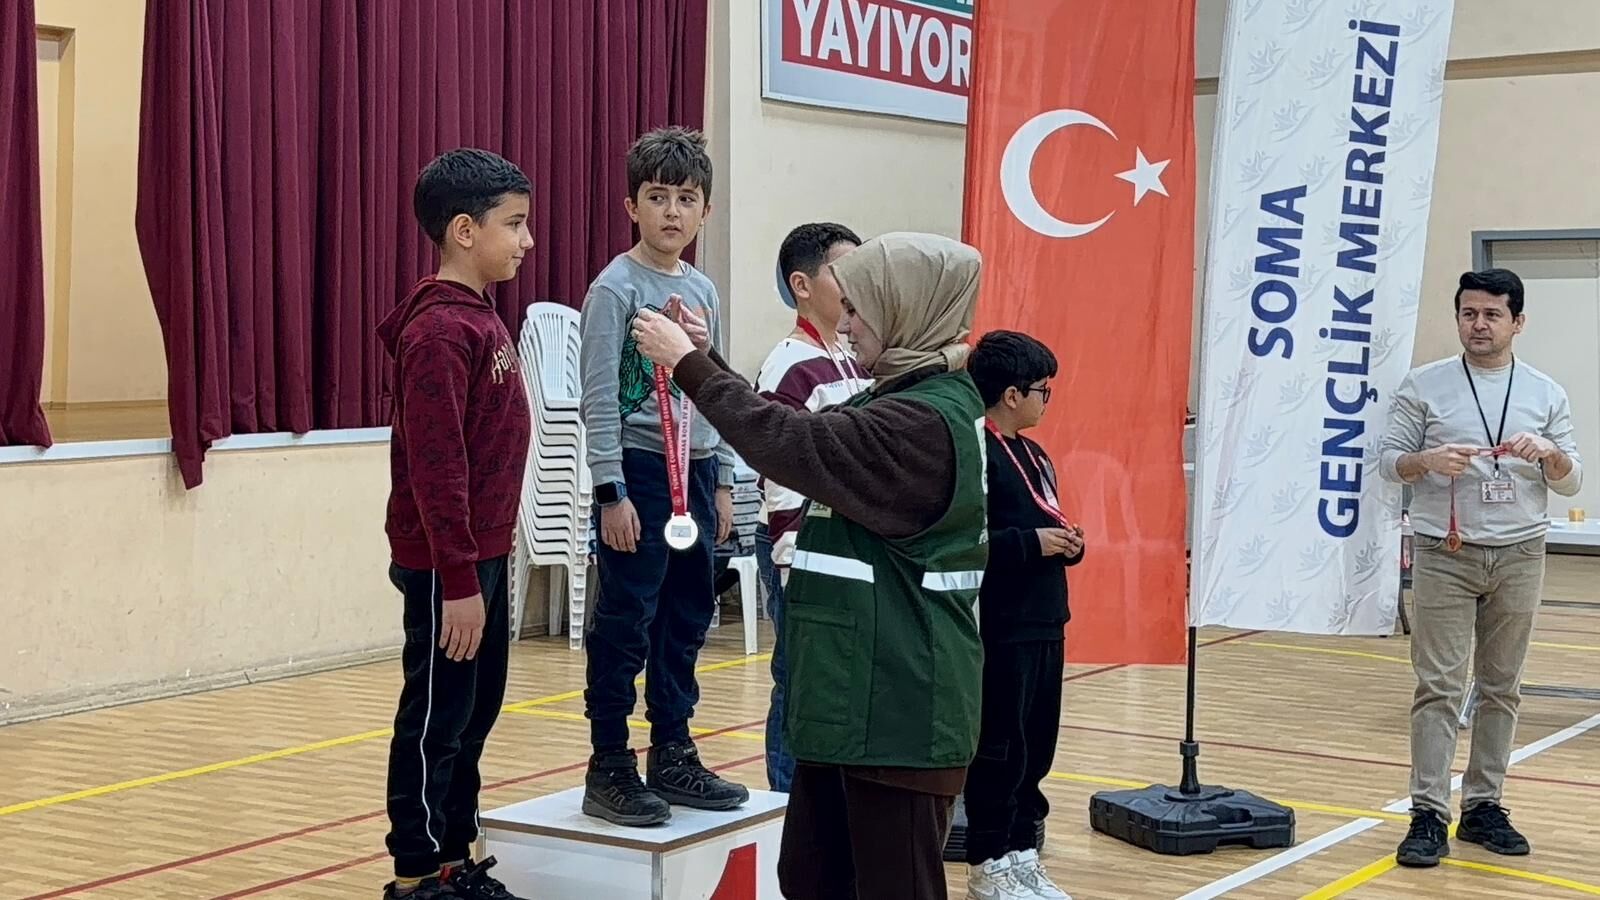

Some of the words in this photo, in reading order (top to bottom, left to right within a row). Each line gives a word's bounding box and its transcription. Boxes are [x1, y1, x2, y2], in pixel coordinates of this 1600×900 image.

[793, 0, 973, 88] YAYIYOR
[1336, 20, 1401, 273] MERKEZİ
[1248, 185, 1307, 359] SOMA
[671, 464, 680, 490] TÜRKİYE
[1317, 286, 1377, 538] GENÇLİK
